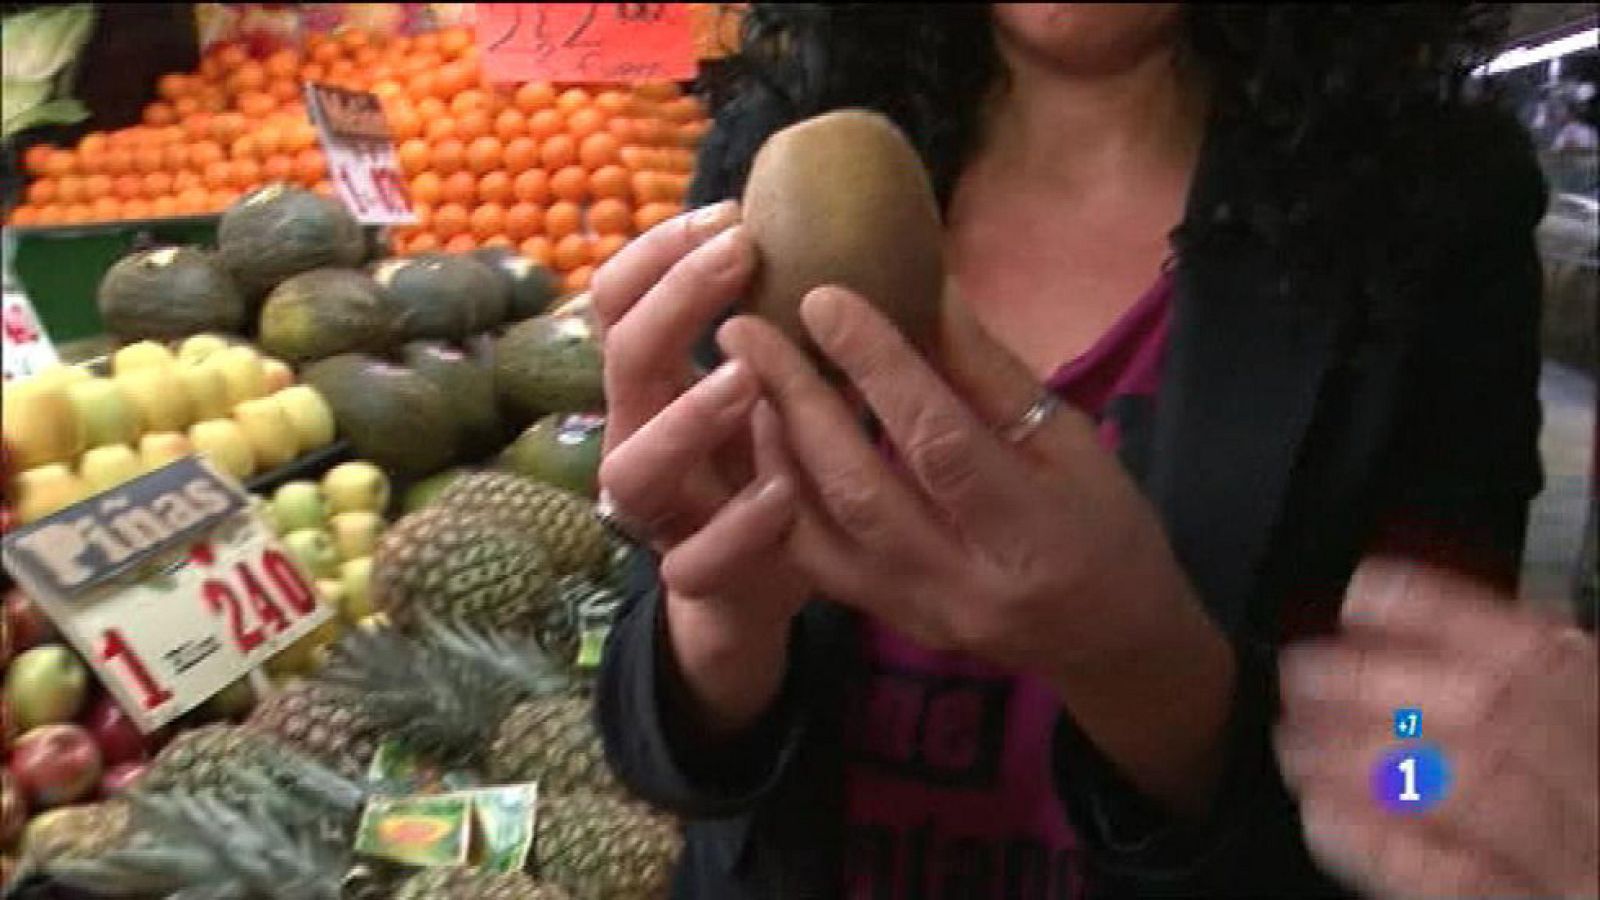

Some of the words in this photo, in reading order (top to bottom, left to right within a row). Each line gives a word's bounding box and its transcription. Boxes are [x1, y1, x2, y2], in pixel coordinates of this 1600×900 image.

[13, 478, 231, 585] Piñas
[98, 629, 174, 710] 1
[202, 549, 316, 655] 240
